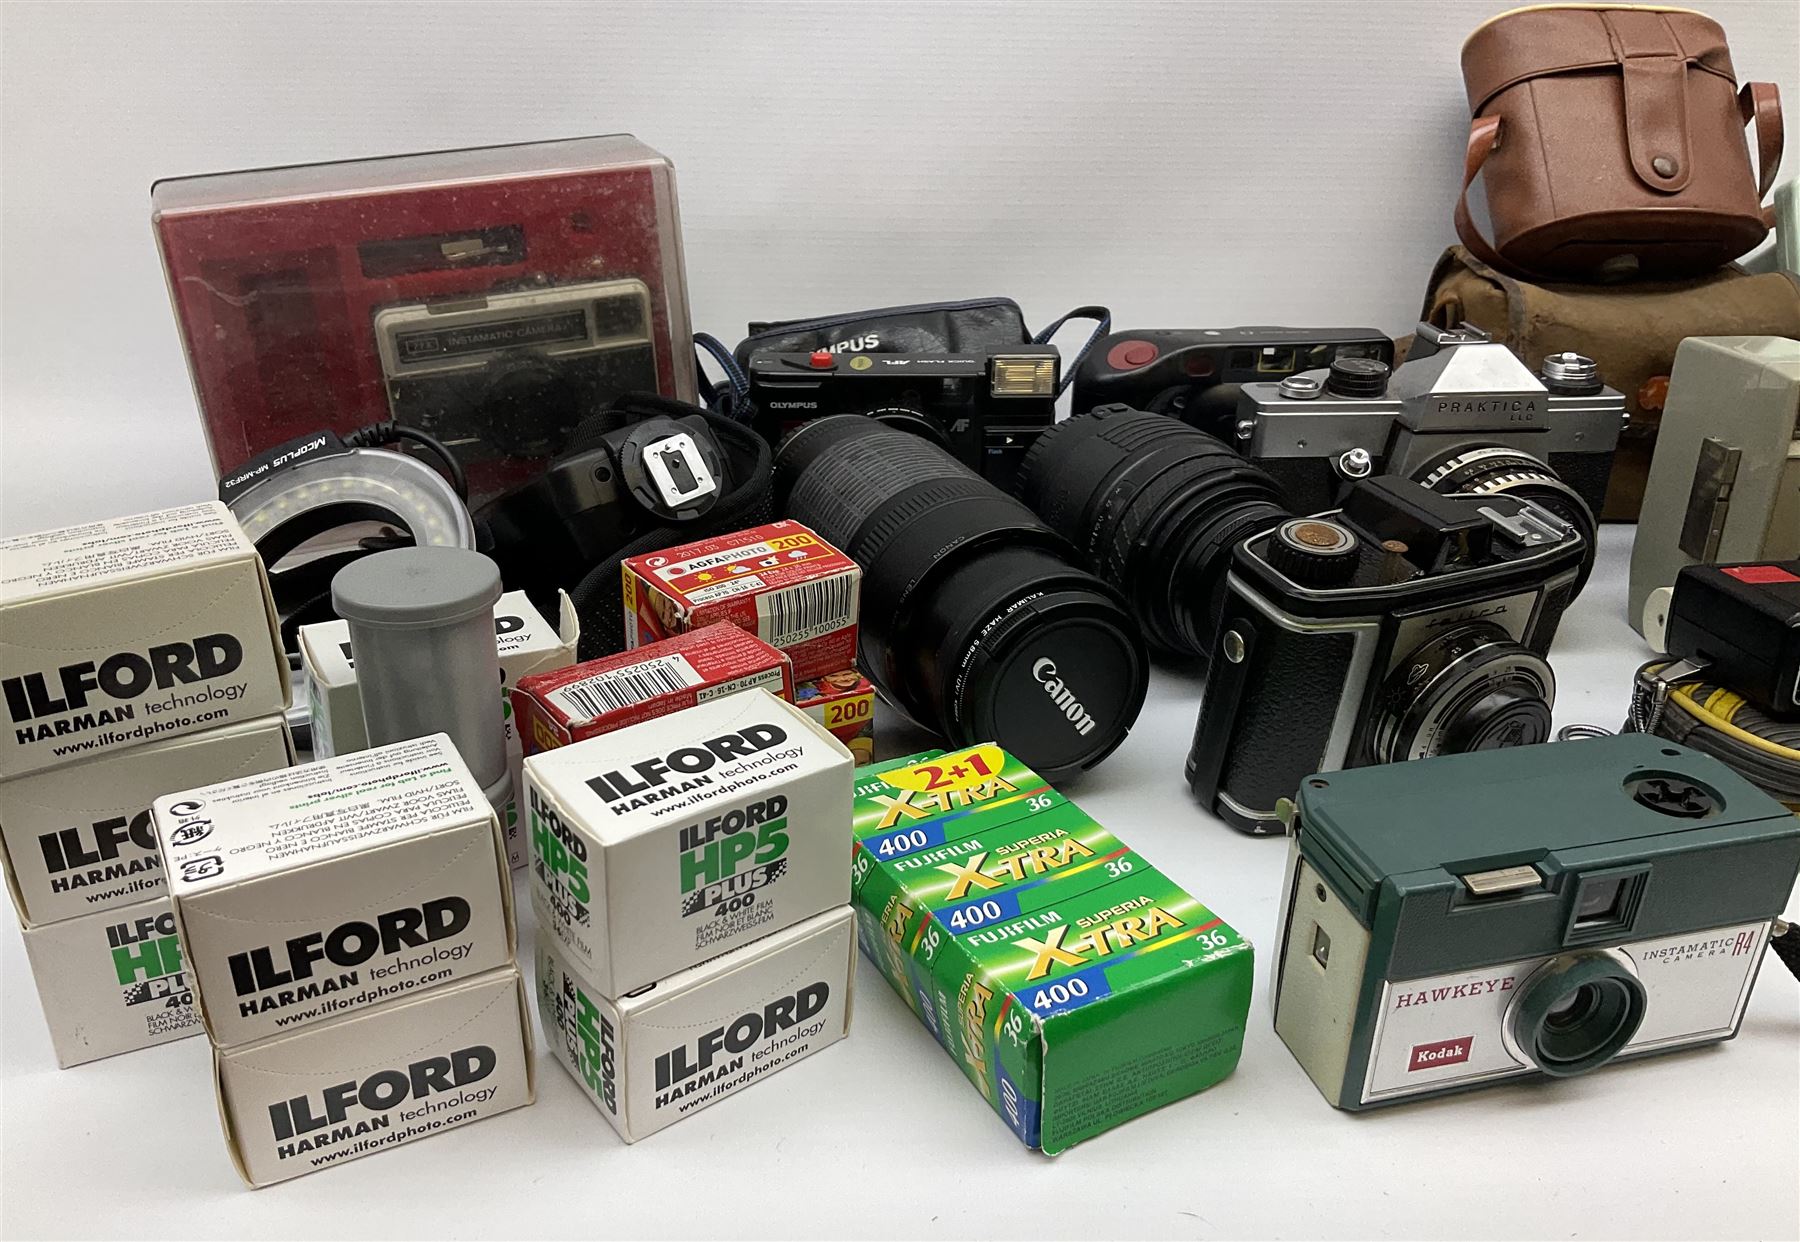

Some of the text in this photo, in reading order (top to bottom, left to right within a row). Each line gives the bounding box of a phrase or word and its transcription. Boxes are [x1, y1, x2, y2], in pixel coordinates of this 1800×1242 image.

[448, 328, 513, 346] INSTAMATIC
[769, 401, 818, 409] OLYMPUS
[1437, 400, 1537, 413] PRAKTICA
[688, 545, 768, 571] AGFAPHOTO
[771, 535, 813, 550] 200
[1006, 591, 1044, 613] KALIMAR
[773, 617, 848, 648] 250255 100055
[980, 614, 1003, 637] HAZE
[1, 633, 243, 722] ILFORD
[616, 659, 665, 677] 250255
[16, 681, 248, 745] HARMAN technology
[831, 699, 869, 723] 200
[1032, 656, 1097, 736] Canon
[53, 708, 229, 757] www.ilfordphoto.com
[585, 723, 788, 804] ILFORD
[610, 745, 805, 817] HARMAN technology
[914, 753, 993, 792] 2+1
[649, 761, 799, 817] www.ilfordphoto.com
[866, 776, 1020, 830] X-TRA
[1025, 793, 1052, 812] 36
[400, 812, 417, 820] PER
[530, 784, 587, 863] ILFORD
[679, 794, 788, 853] ILFORD
[38, 808, 156, 875] ILFO
[229, 840, 270, 854] NEGRO
[265, 841, 296, 853] NERO
[310, 827, 354, 842] BIANCO
[878, 829, 928, 856] 400
[995, 828, 1070, 856] SUPERIA
[531, 808, 591, 904] HP5
[680, 816, 790, 895] HP5
[851, 852, 869, 886] 36
[893, 839, 984, 872] FUJIFILM
[933, 838, 1096, 902] X-TRA
[1103, 856, 1133, 879] 36
[51, 855, 161, 894] HARMAN
[86, 875, 167, 905] www.ilfor
[543, 866, 579, 913] PLUS
[704, 866, 768, 907] PLUS
[696, 918, 720, 934] BLACK
[729, 906, 755, 920] WHITE
[756, 899, 774, 910] FILM
[714, 892, 756, 917] 400
[880, 894, 898, 928] PERIA
[950, 900, 1002, 929] 400
[1075, 895, 1155, 929] SUPERIA
[106, 911, 177, 948] ILFO
[696, 931, 713, 942] FILM
[747, 907, 773, 922] BLANC
[968, 911, 1063, 948] FUJIFILM
[1195, 929, 1228, 952] 36
[111, 935, 183, 986] HP
[228, 896, 471, 998] ILFORD
[920, 925, 940, 961] 36
[1011, 907, 1187, 981] X-TRA
[1642, 930, 1755, 961] INSTAMATIC R4
[1662, 948, 1727, 964] CAMERA
[238, 942, 474, 1019] HARMAN technology
[275, 967, 453, 1028] www.ilfordphoto.com
[1032, 977, 1089, 1011] 400
[1395, 976, 1517, 1010] HAWKEYE
[147, 1010, 173, 1022] BLACK
[165, 992, 193, 1008] 40
[956, 973, 975, 1027] SUPERIA
[148, 1019, 168, 1030] FILM
[148, 1016, 201, 1036] SCHWARZW
[655, 981, 830, 1093] ILFORD
[960, 981, 995, 1100] X-TRA
[1003, 1008, 1023, 1047] 36
[576, 987, 604, 1101] HP5
[1416, 1044, 1464, 1064] Kodak
[600, 1013, 617, 1116] ILFORD
[655, 1018, 827, 1110] HARMAN technology
[678, 1042, 809, 1113] www.ilfordphoto.com
[268, 1044, 497, 1142] ILFORD
[1001, 1077, 1020, 1127] 400
[277, 1085, 498, 1160] HARMAN technology
[310, 1107, 478, 1167] www.ilfordphoto.com
